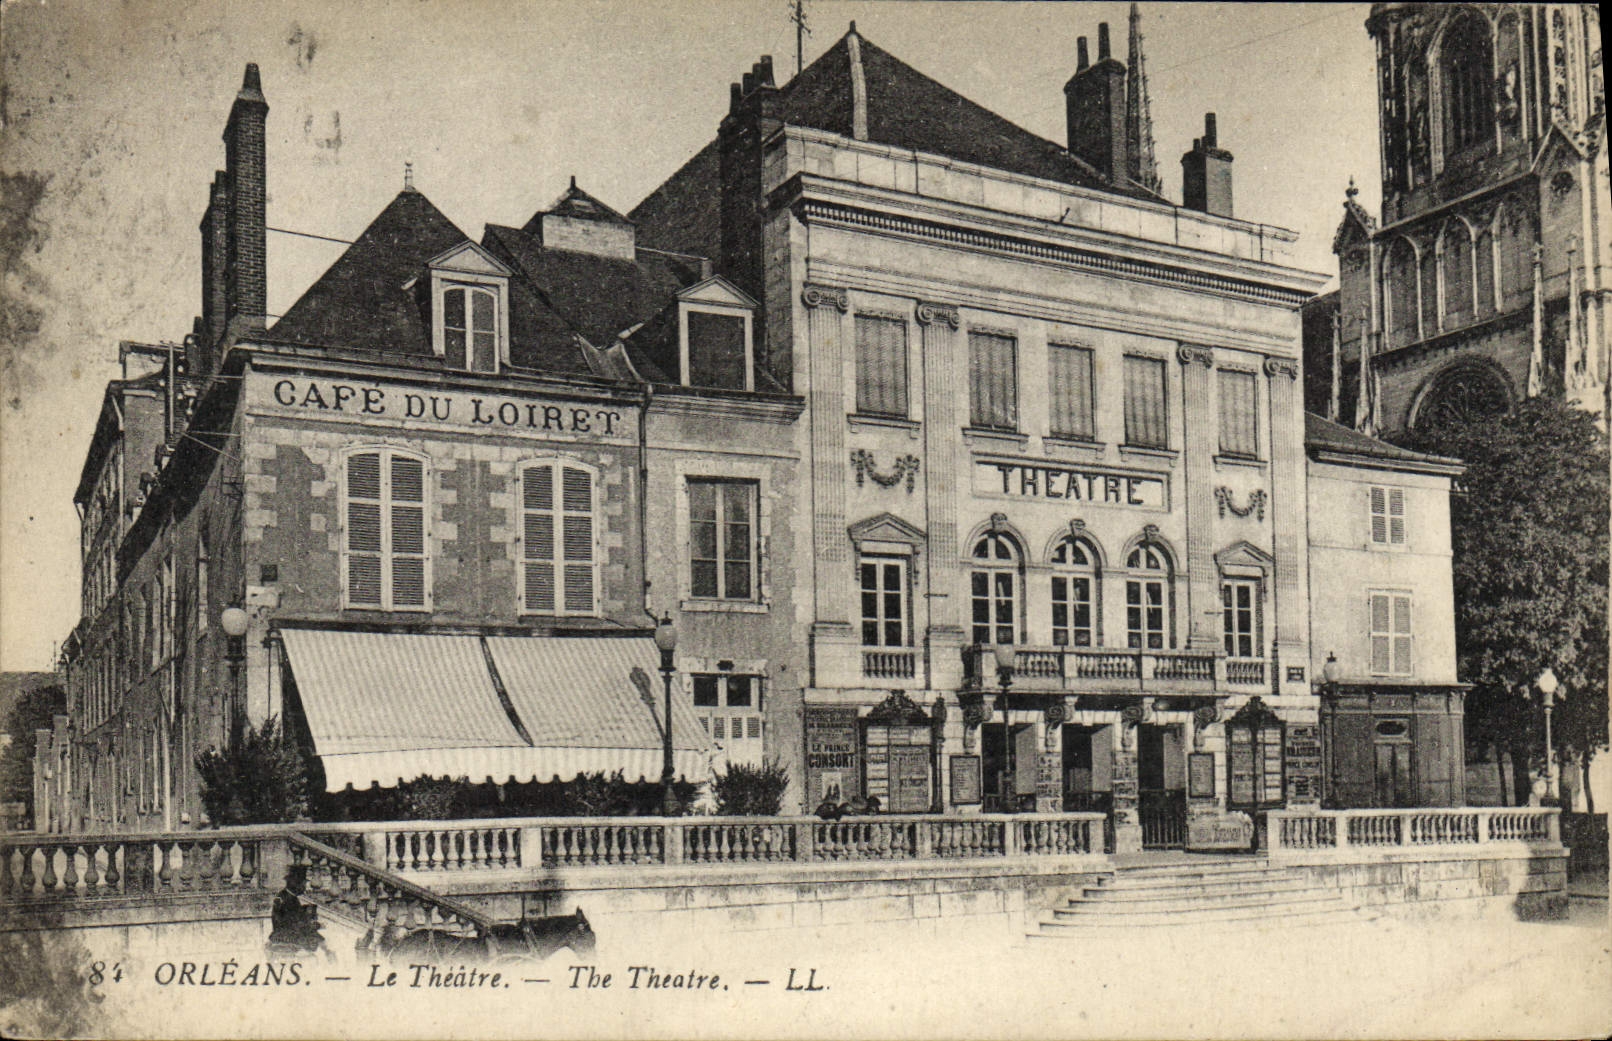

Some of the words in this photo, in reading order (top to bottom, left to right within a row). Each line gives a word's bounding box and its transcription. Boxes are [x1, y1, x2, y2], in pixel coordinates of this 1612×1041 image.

[405, 393, 452, 421] DU
[472, 398, 621, 435] LOIRET
[997, 464, 1144, 505] THEATRE
[808, 753, 855, 768] CONSORT
